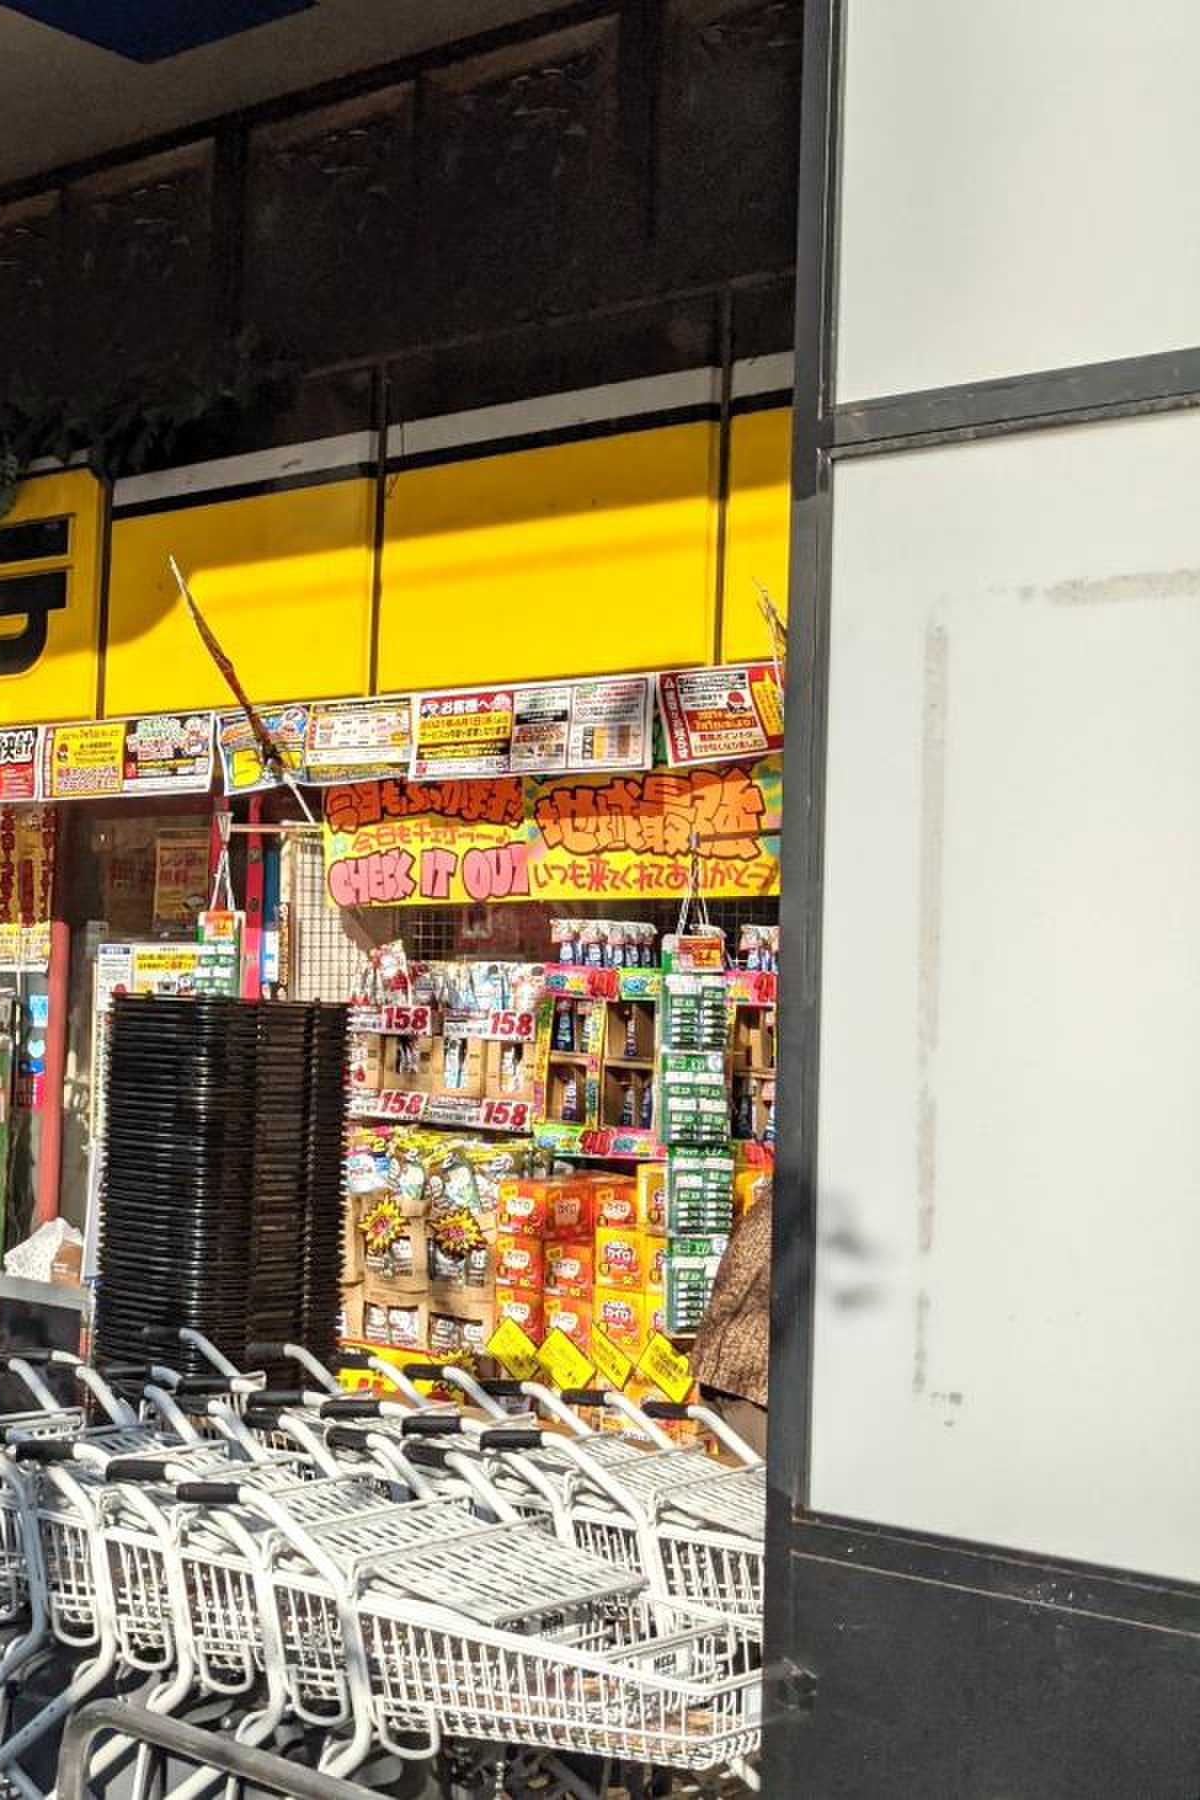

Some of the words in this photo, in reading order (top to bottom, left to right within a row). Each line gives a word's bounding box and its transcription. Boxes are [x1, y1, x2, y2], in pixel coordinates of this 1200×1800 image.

[328, 847, 417, 907] CHECK
[419, 848, 459, 899] IT
[462, 842, 530, 900] OUT
[383, 1006, 430, 1031] 158
[490, 1011, 535, 1037] 158
[380, 1090, 426, 1115] 158
[483, 1101, 529, 1127] 158
